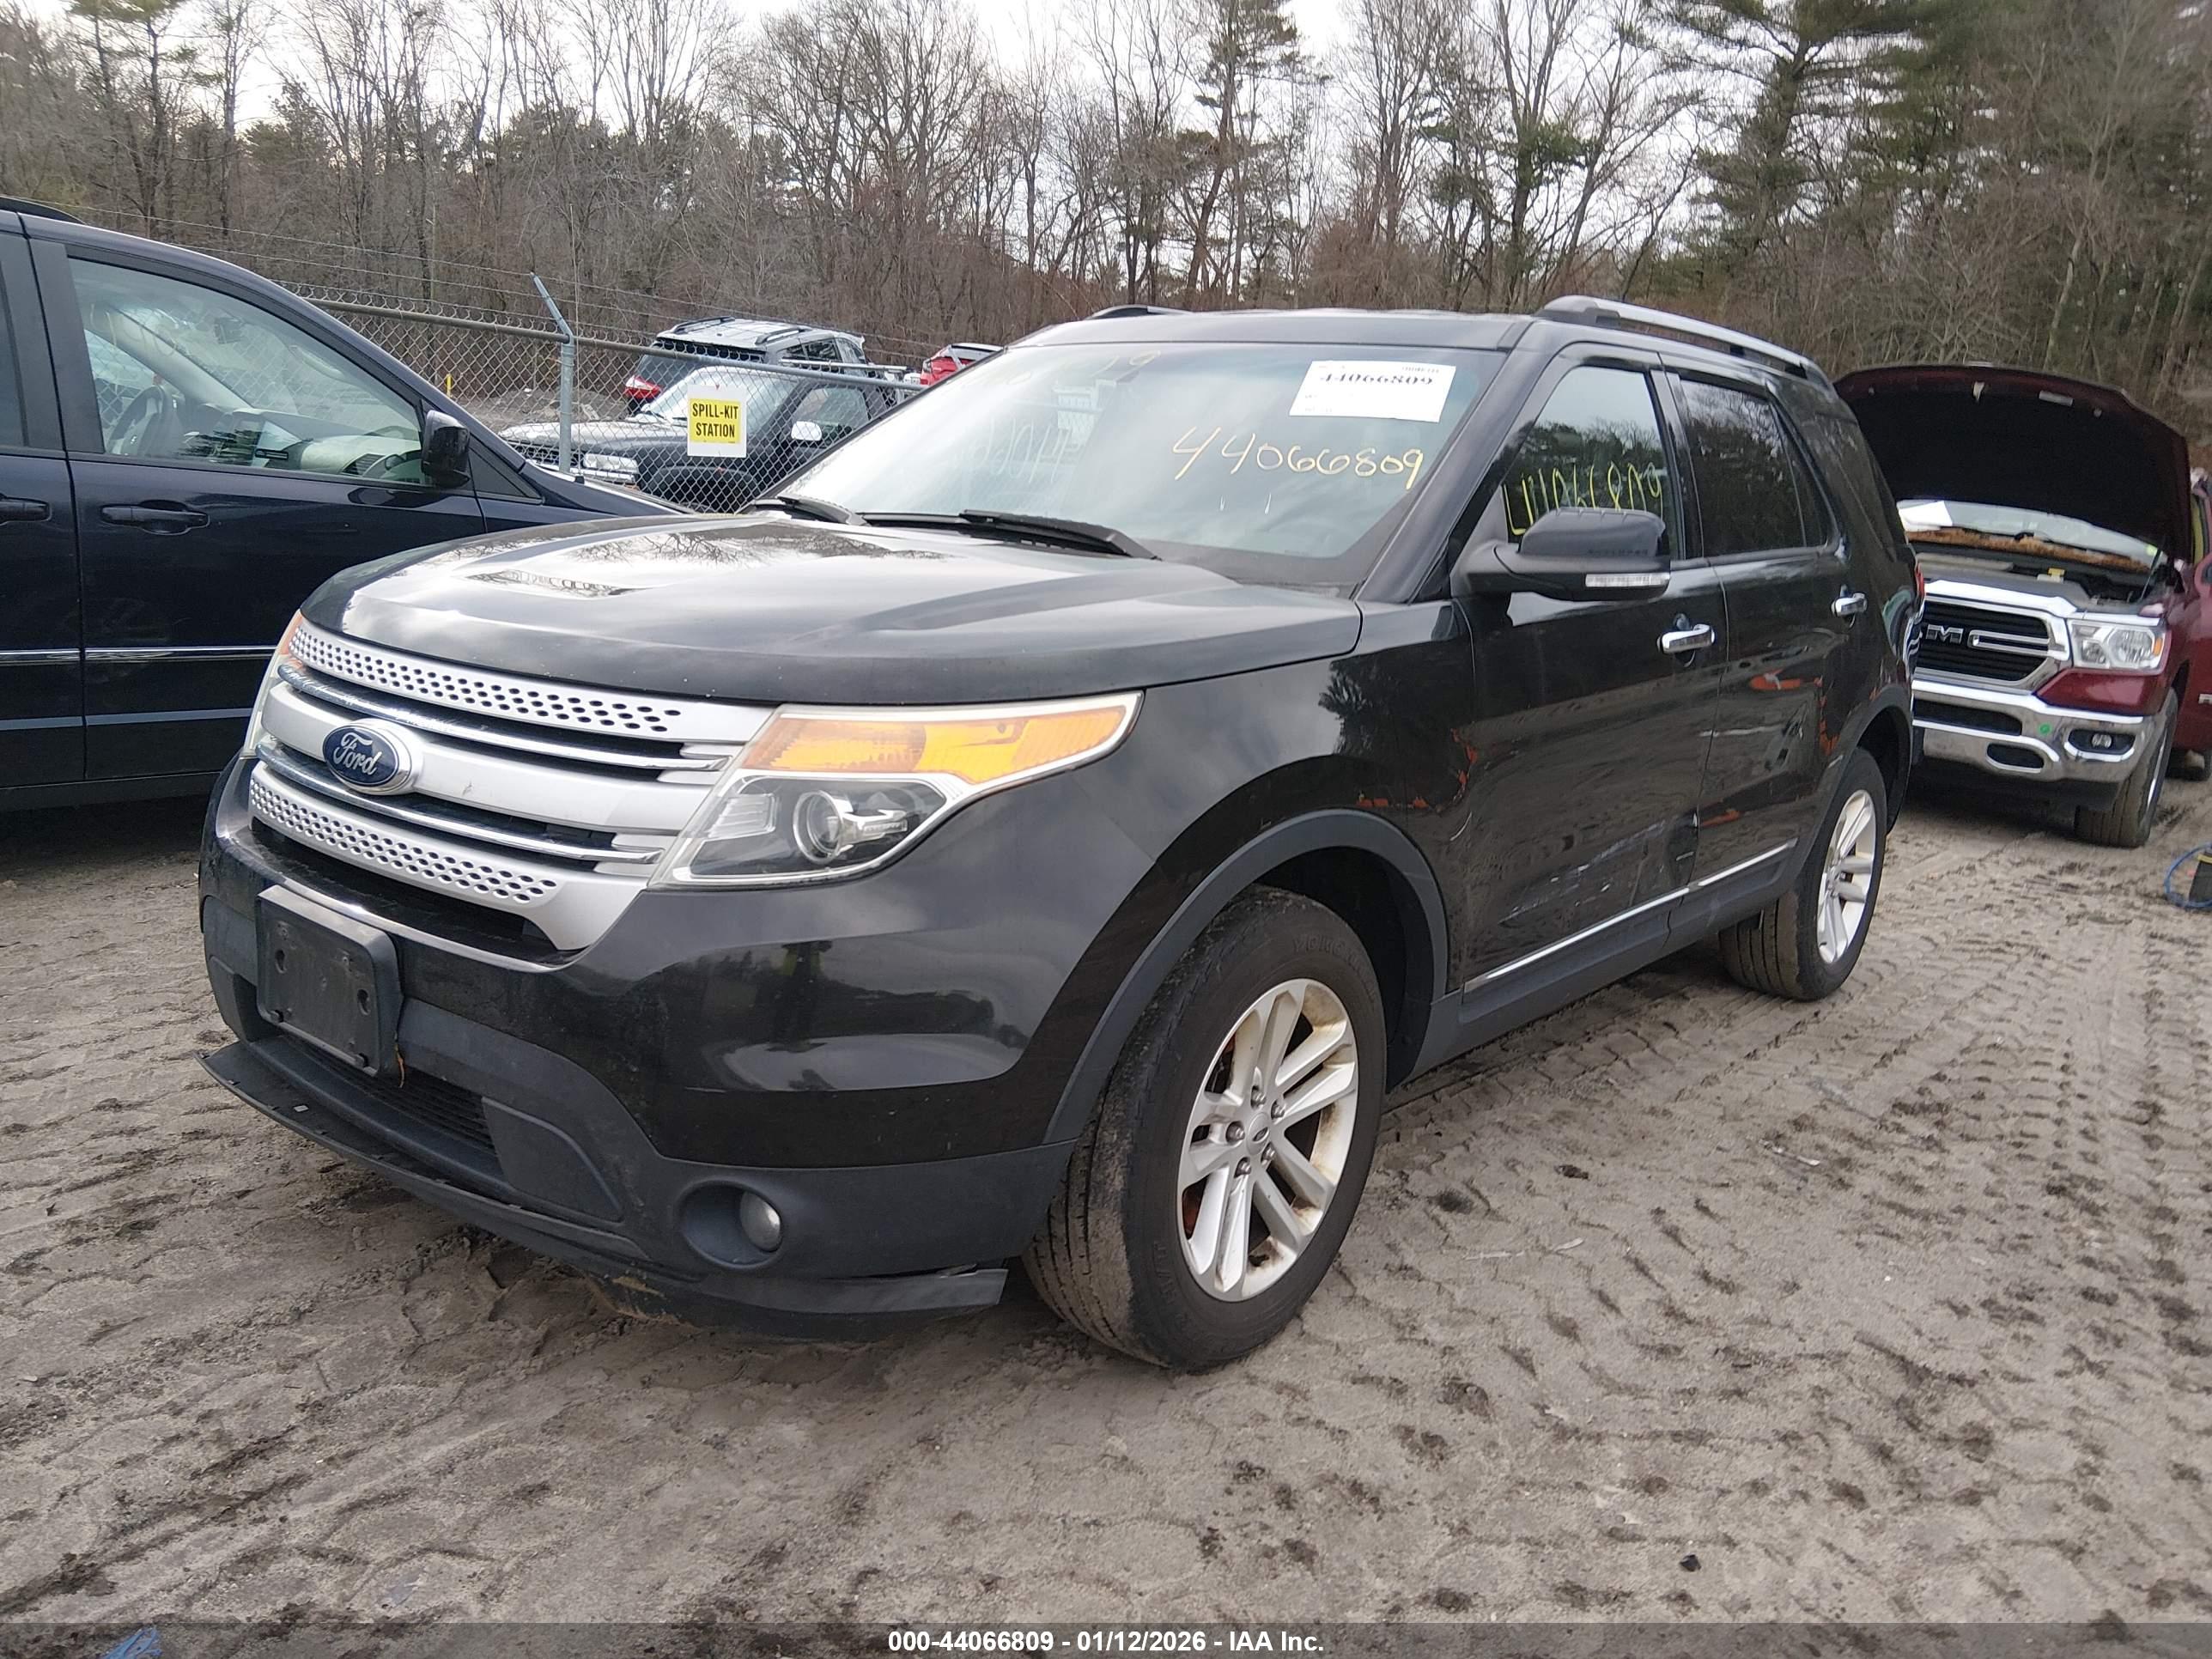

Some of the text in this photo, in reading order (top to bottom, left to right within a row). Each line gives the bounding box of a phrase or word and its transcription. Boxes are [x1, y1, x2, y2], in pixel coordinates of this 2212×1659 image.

[692, 403, 738, 419] SPILL-KIT
[696, 422, 735, 438] STATION
[1172, 427, 1424, 489] 44066809
[333, 732, 383, 775] Ford
